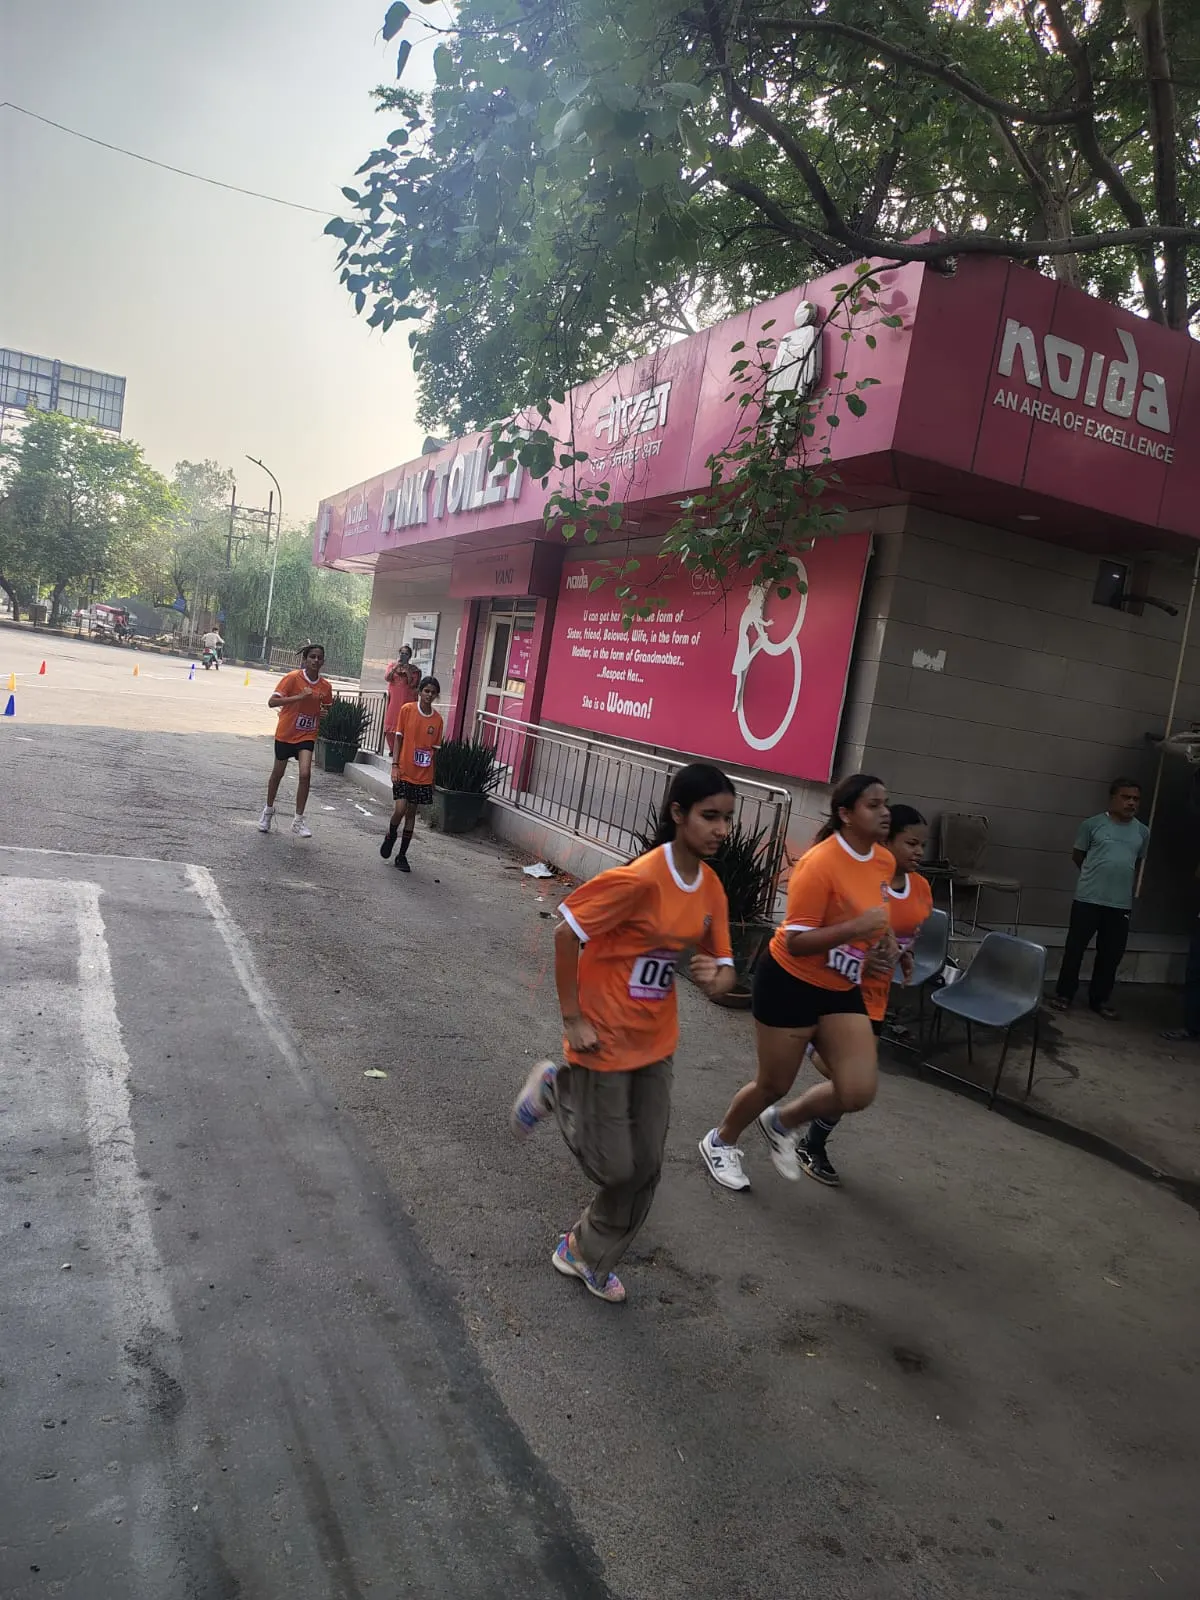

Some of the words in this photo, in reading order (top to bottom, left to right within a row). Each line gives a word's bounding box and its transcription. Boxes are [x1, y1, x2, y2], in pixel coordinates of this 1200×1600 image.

[998, 318, 1170, 433] noida
[993, 389, 1018, 411] AN
[1020, 397, 1061, 426] AREA
[1063, 412, 1084, 432] OF
[1084, 419, 1175, 464] EXCELLENCE
[380, 469, 435, 535] PINK
[583, 610, 588, 621] U
[588, 612, 599, 622] can
[599, 611, 609, 624] get
[610, 610, 620, 622] her
[656, 610, 673, 623] form
[674, 610, 684, 623] of
[567, 628, 582, 640] Sister,
[603, 628, 629, 643] Beloved,
[631, 630, 648, 645] Wife,
[650, 630, 657, 643] in
[658, 630, 670, 643] the
[671, 630, 689, 645] form
[691, 632, 701, 645] of
[572, 645, 592, 660] Mother,
[593, 647, 599, 658] in
[599, 647, 609, 659] the
[610, 647, 624, 660] form
[625, 649, 634, 661] of
[582, 695, 592, 709] She
[593, 697, 599, 709] is
[600, 702, 605, 710] a
[606, 691, 654, 719] Woman!
[640, 960, 674, 988] 06
